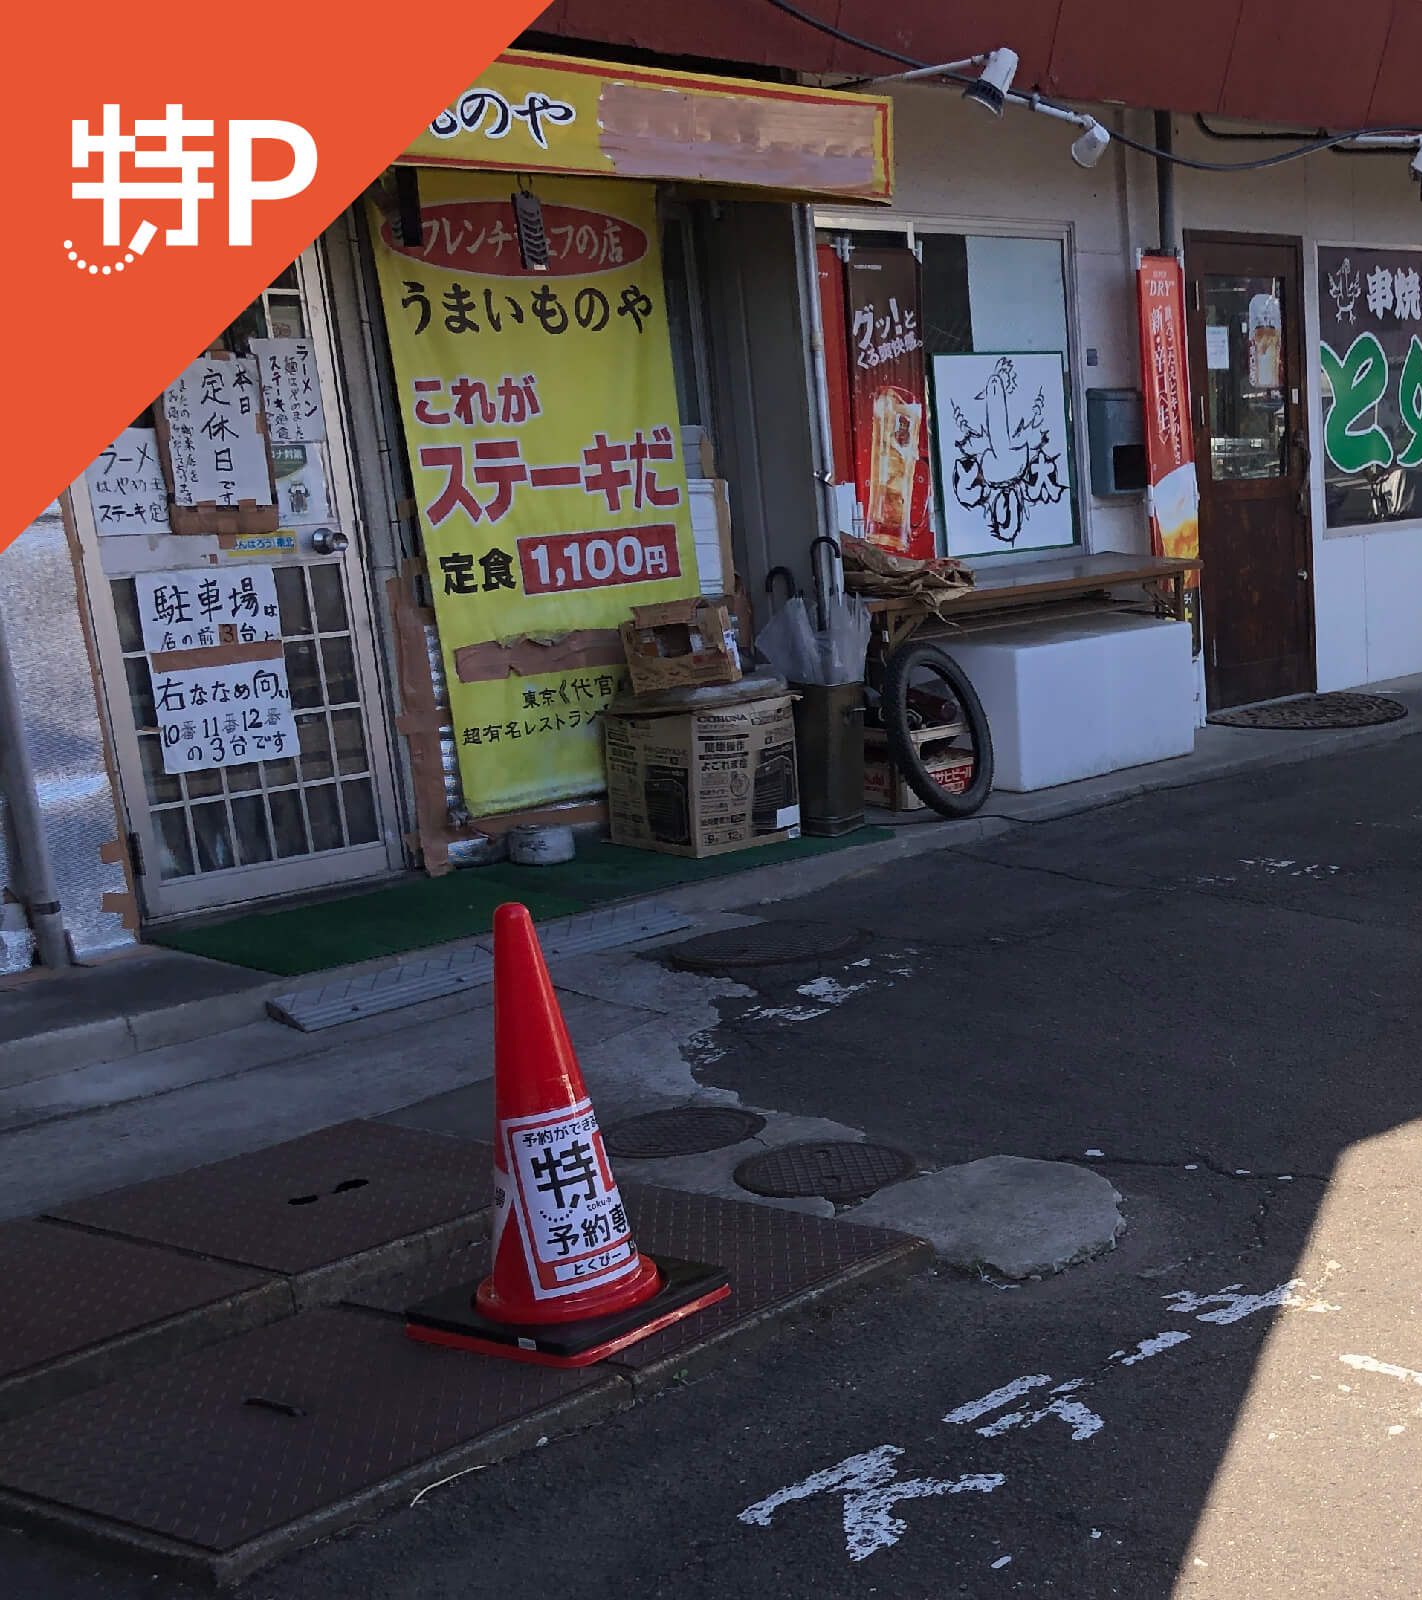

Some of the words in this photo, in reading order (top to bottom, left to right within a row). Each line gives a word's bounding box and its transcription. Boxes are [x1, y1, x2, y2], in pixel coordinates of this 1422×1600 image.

[422, 219, 623, 265] フレンチェフの店
[401, 281, 653, 335] うまいものや
[232, 364, 253, 415] 本日
[296, 345, 317, 417] ラーメン
[414, 374, 541, 425] これが
[201, 367, 239, 505] 定休日です
[419, 426, 680, 527] ステーキだ
[439, 548, 517, 595] 定食
[530, 536, 668, 587] 1,100円
[152, 577, 277, 625] 駐車場は
[522, 675, 624, 709] 東京《代官
[188, 731, 287, 761] の3台です
[574, 1253, 622, 1276] とくぴー
